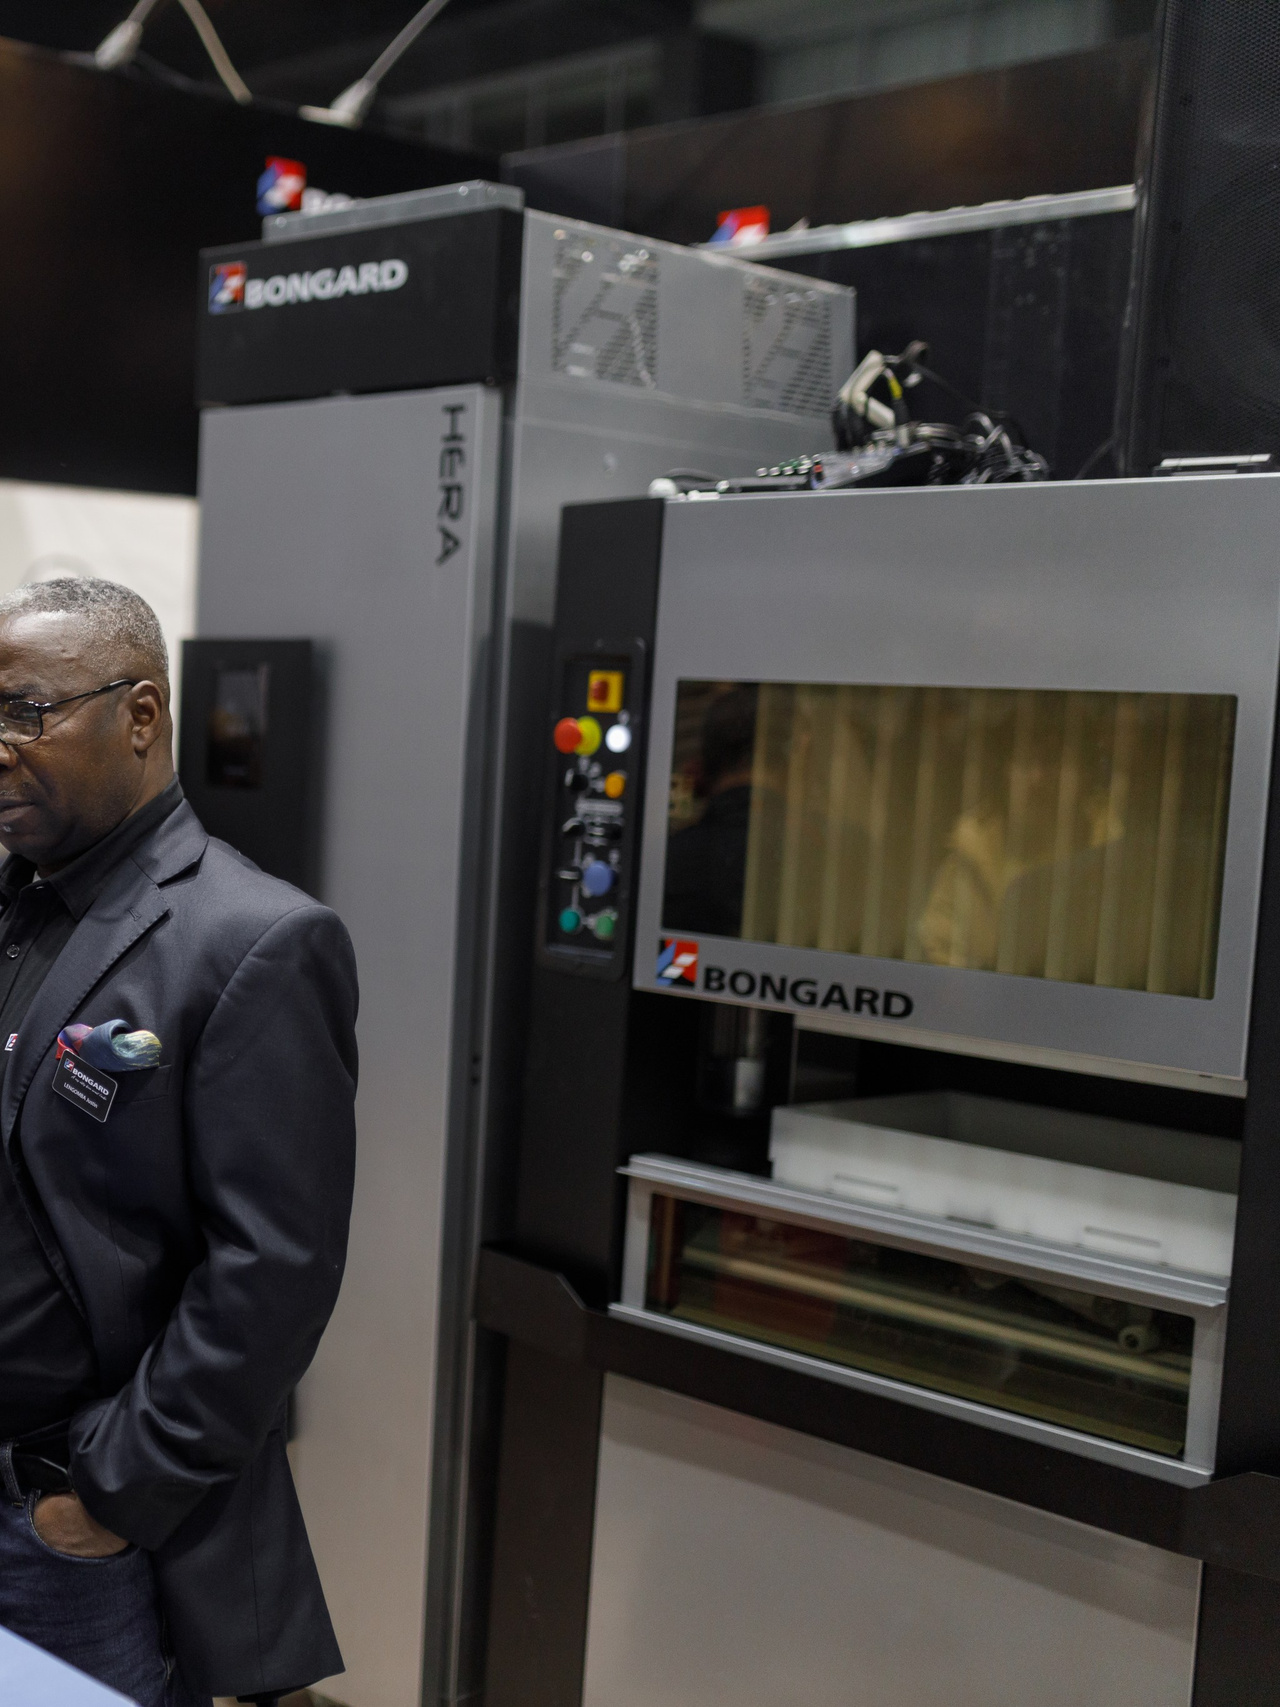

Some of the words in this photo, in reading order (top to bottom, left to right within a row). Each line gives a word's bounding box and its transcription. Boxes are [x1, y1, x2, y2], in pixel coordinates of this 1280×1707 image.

[244, 259, 408, 310] BONGARD
[435, 403, 466, 566] HERA
[702, 964, 914, 1020] BONGARD
[72, 1067, 110, 1096] BONGARD
